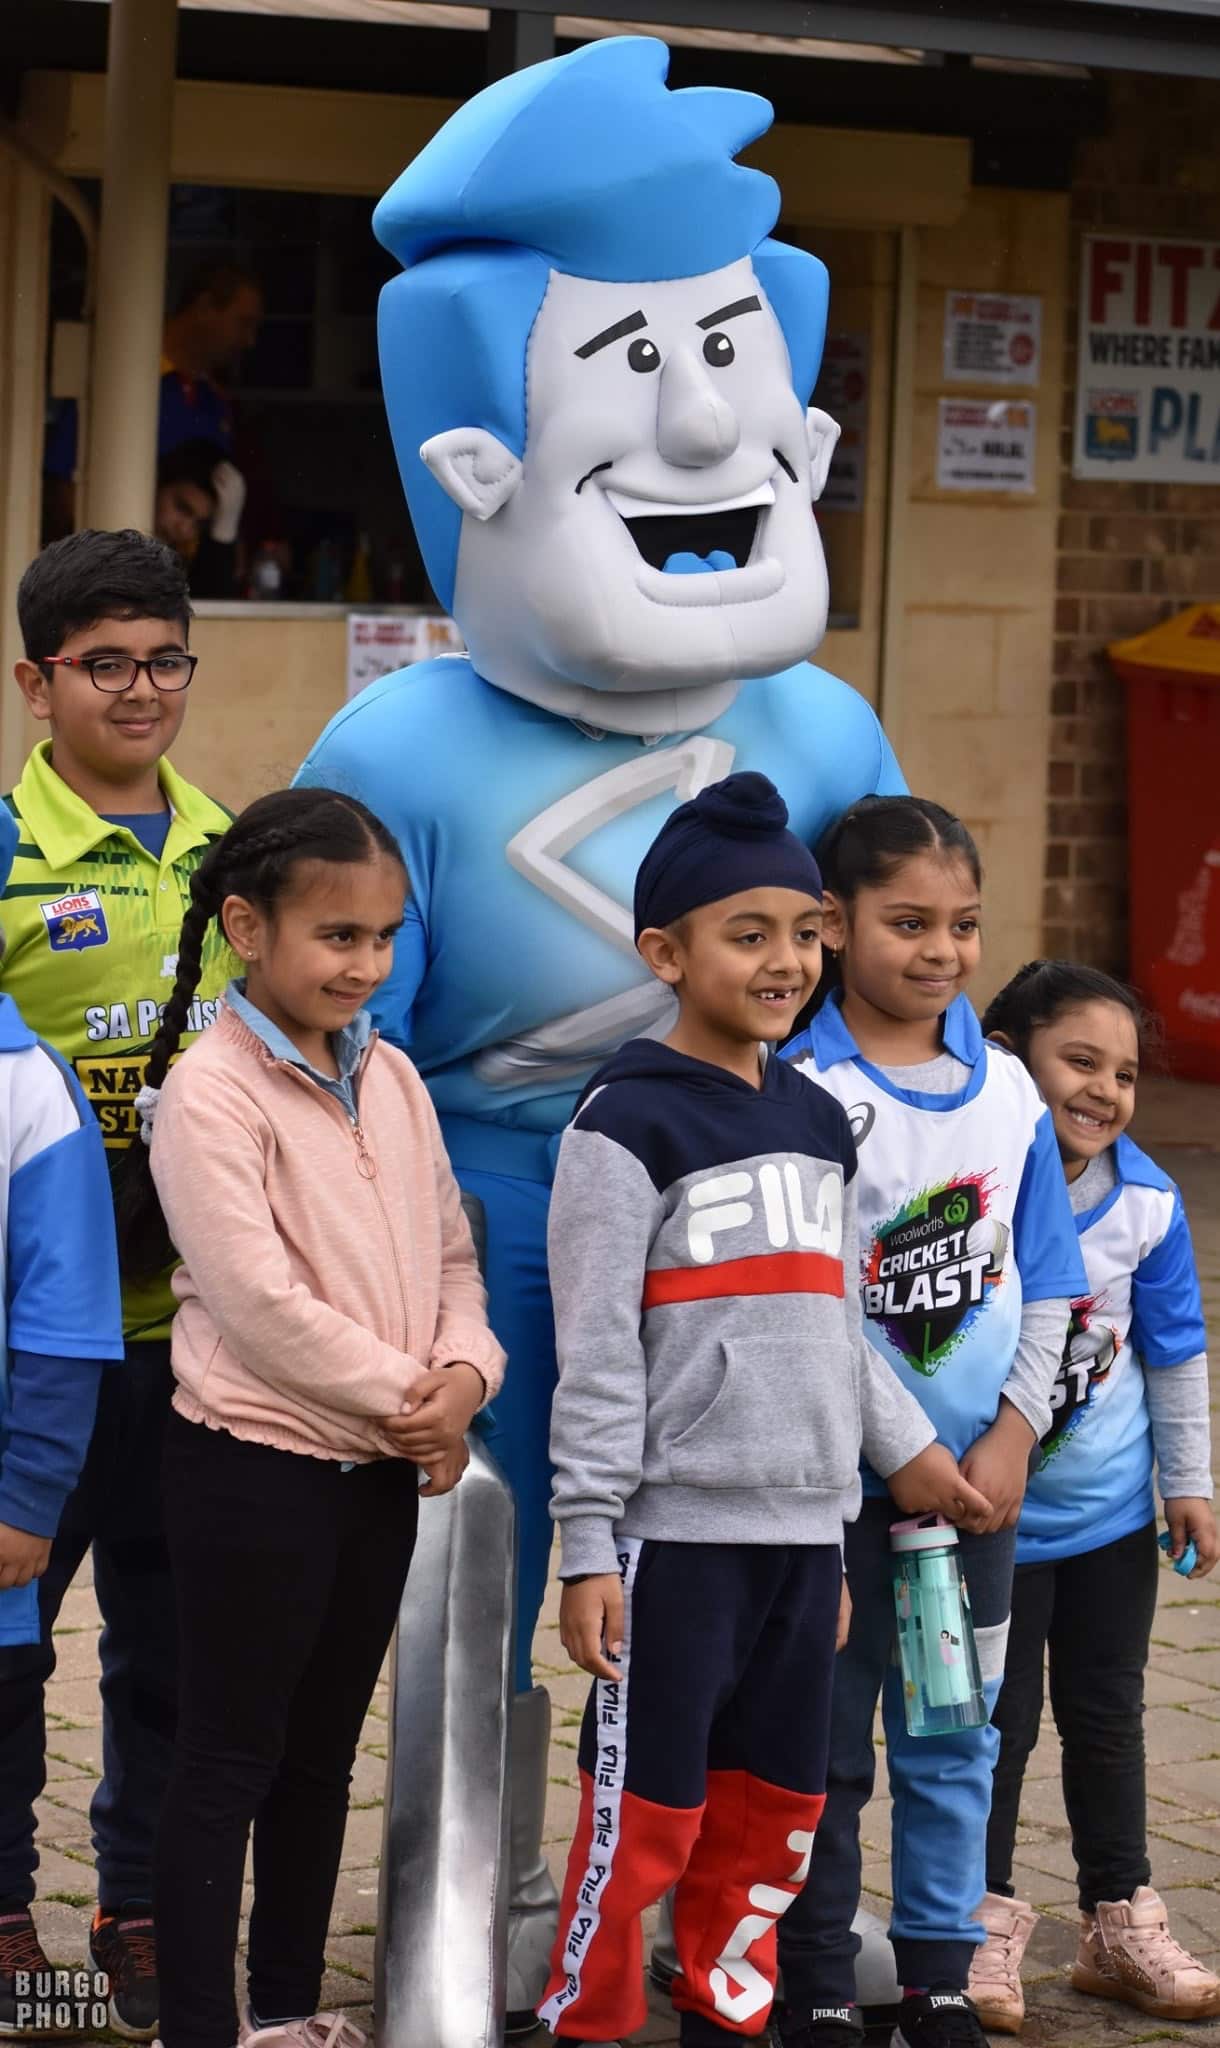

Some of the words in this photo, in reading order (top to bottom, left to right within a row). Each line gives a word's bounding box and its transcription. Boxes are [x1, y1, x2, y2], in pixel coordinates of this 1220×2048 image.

[1089, 331, 1171, 370] WHERE
[51, 896, 90, 915] LIONS
[85, 1003, 132, 1041] SA
[688, 1161, 843, 1264] FILA
[878, 1229, 965, 1279] CRICKET
[864, 1252, 991, 1315] BLAST
[602, 1682, 620, 1725] FILA
[598, 1744, 618, 1788] FILA
[596, 1806, 612, 1848] FILA
[581, 1864, 607, 1905] FILA
[568, 1917, 592, 1958] FILA
[812, 2008, 851, 2022] EVERLAST
[929, 1995, 968, 2009] EVERLAST
